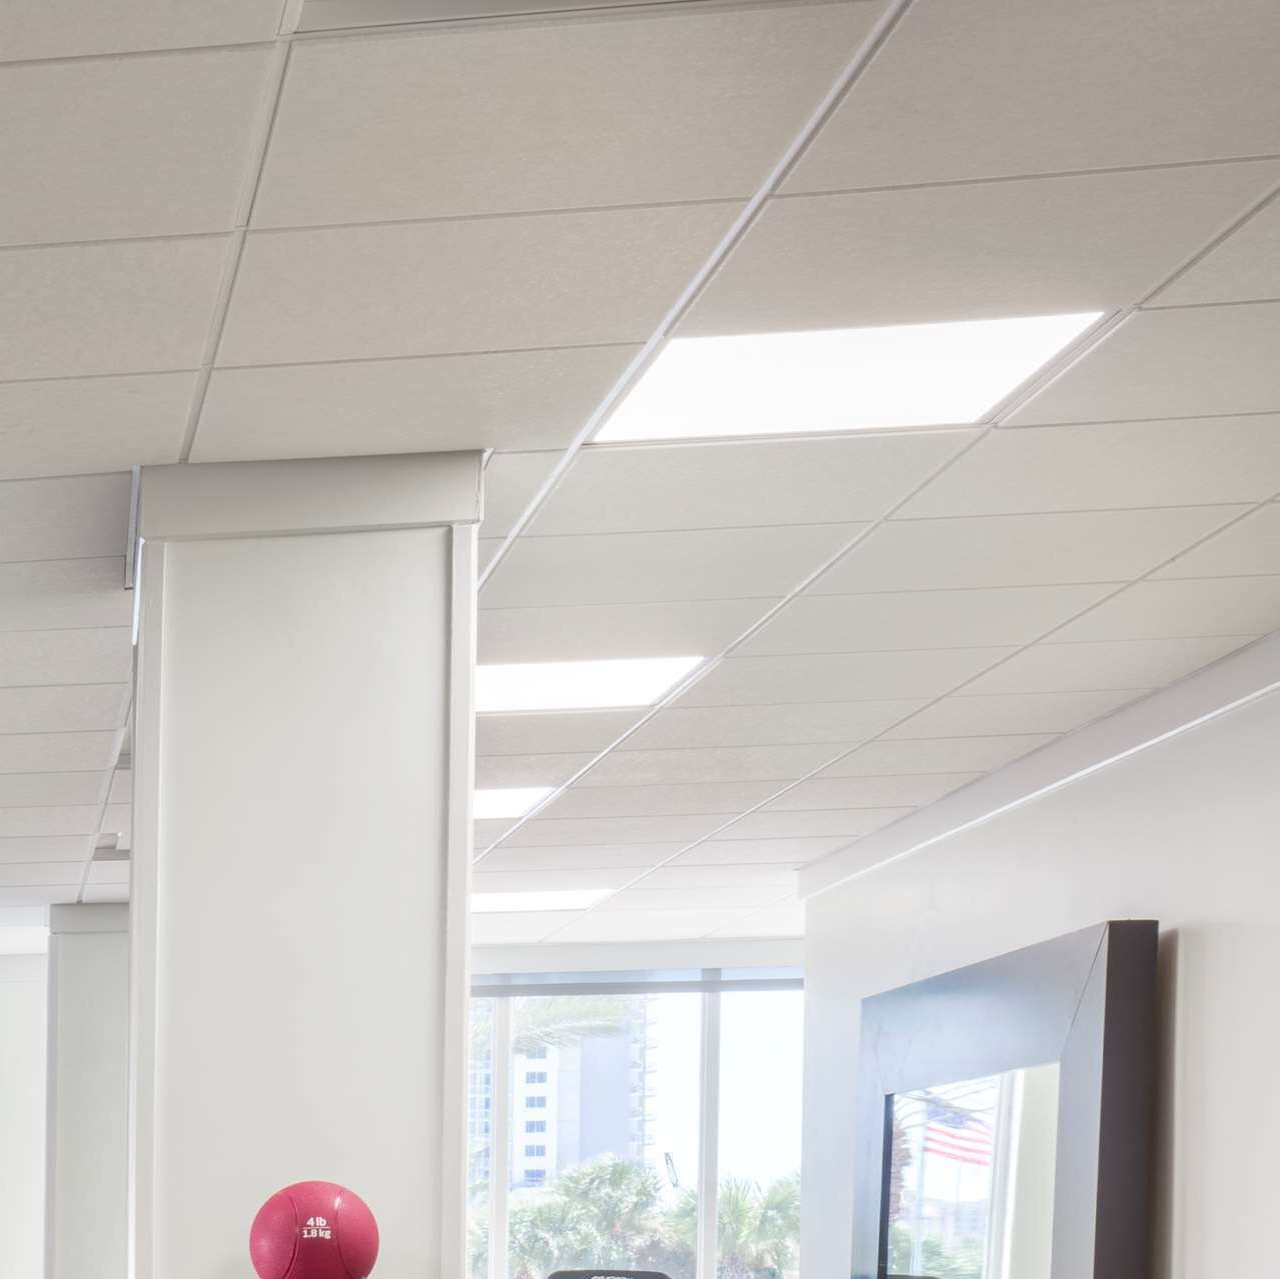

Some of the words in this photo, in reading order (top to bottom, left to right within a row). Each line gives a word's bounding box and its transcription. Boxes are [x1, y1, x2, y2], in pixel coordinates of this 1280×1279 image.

[306, 1216, 315, 1227] 4
[316, 1216, 327, 1227] lb
[319, 1228, 331, 1239] kg
